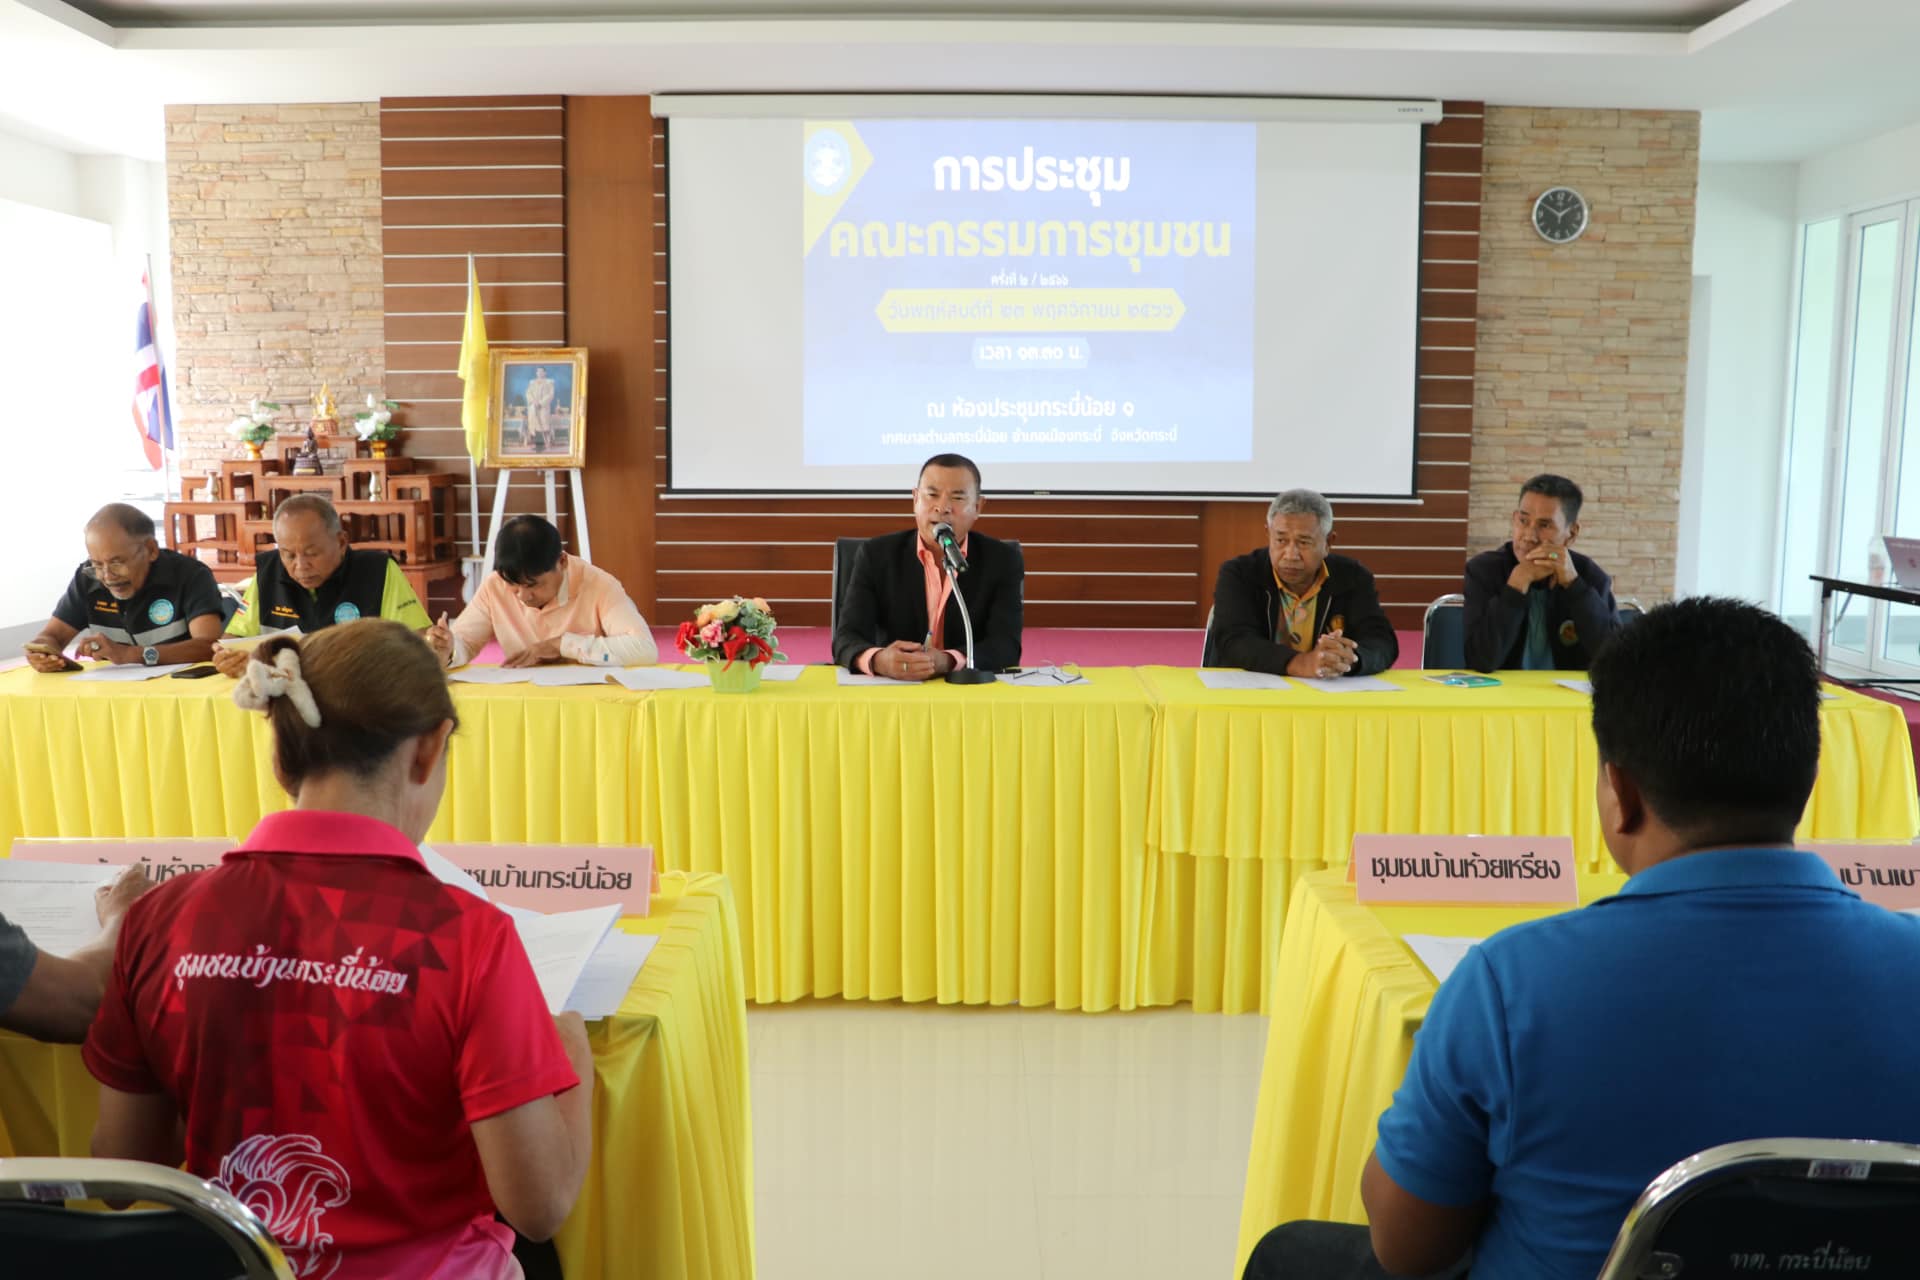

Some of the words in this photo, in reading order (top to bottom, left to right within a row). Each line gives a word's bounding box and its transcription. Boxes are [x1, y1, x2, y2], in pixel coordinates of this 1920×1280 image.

[933, 146, 1130, 207] การประชุม
[828, 219, 1232, 273] คณะกรรมการชุมชน
[979, 345, 1012, 361] เวลา
[927, 402, 946, 419] ณ
[951, 391, 1116, 424] ห้องประชุมกระบี่น้อย
[463, 859, 633, 890] ชนบ้านกระบี่น้อย
[1371, 851, 1562, 884] ชุมชนบ้านห้วยเหรียง
[174, 944, 408, 994] ชุมชนบ้านกระบี่น้อย
